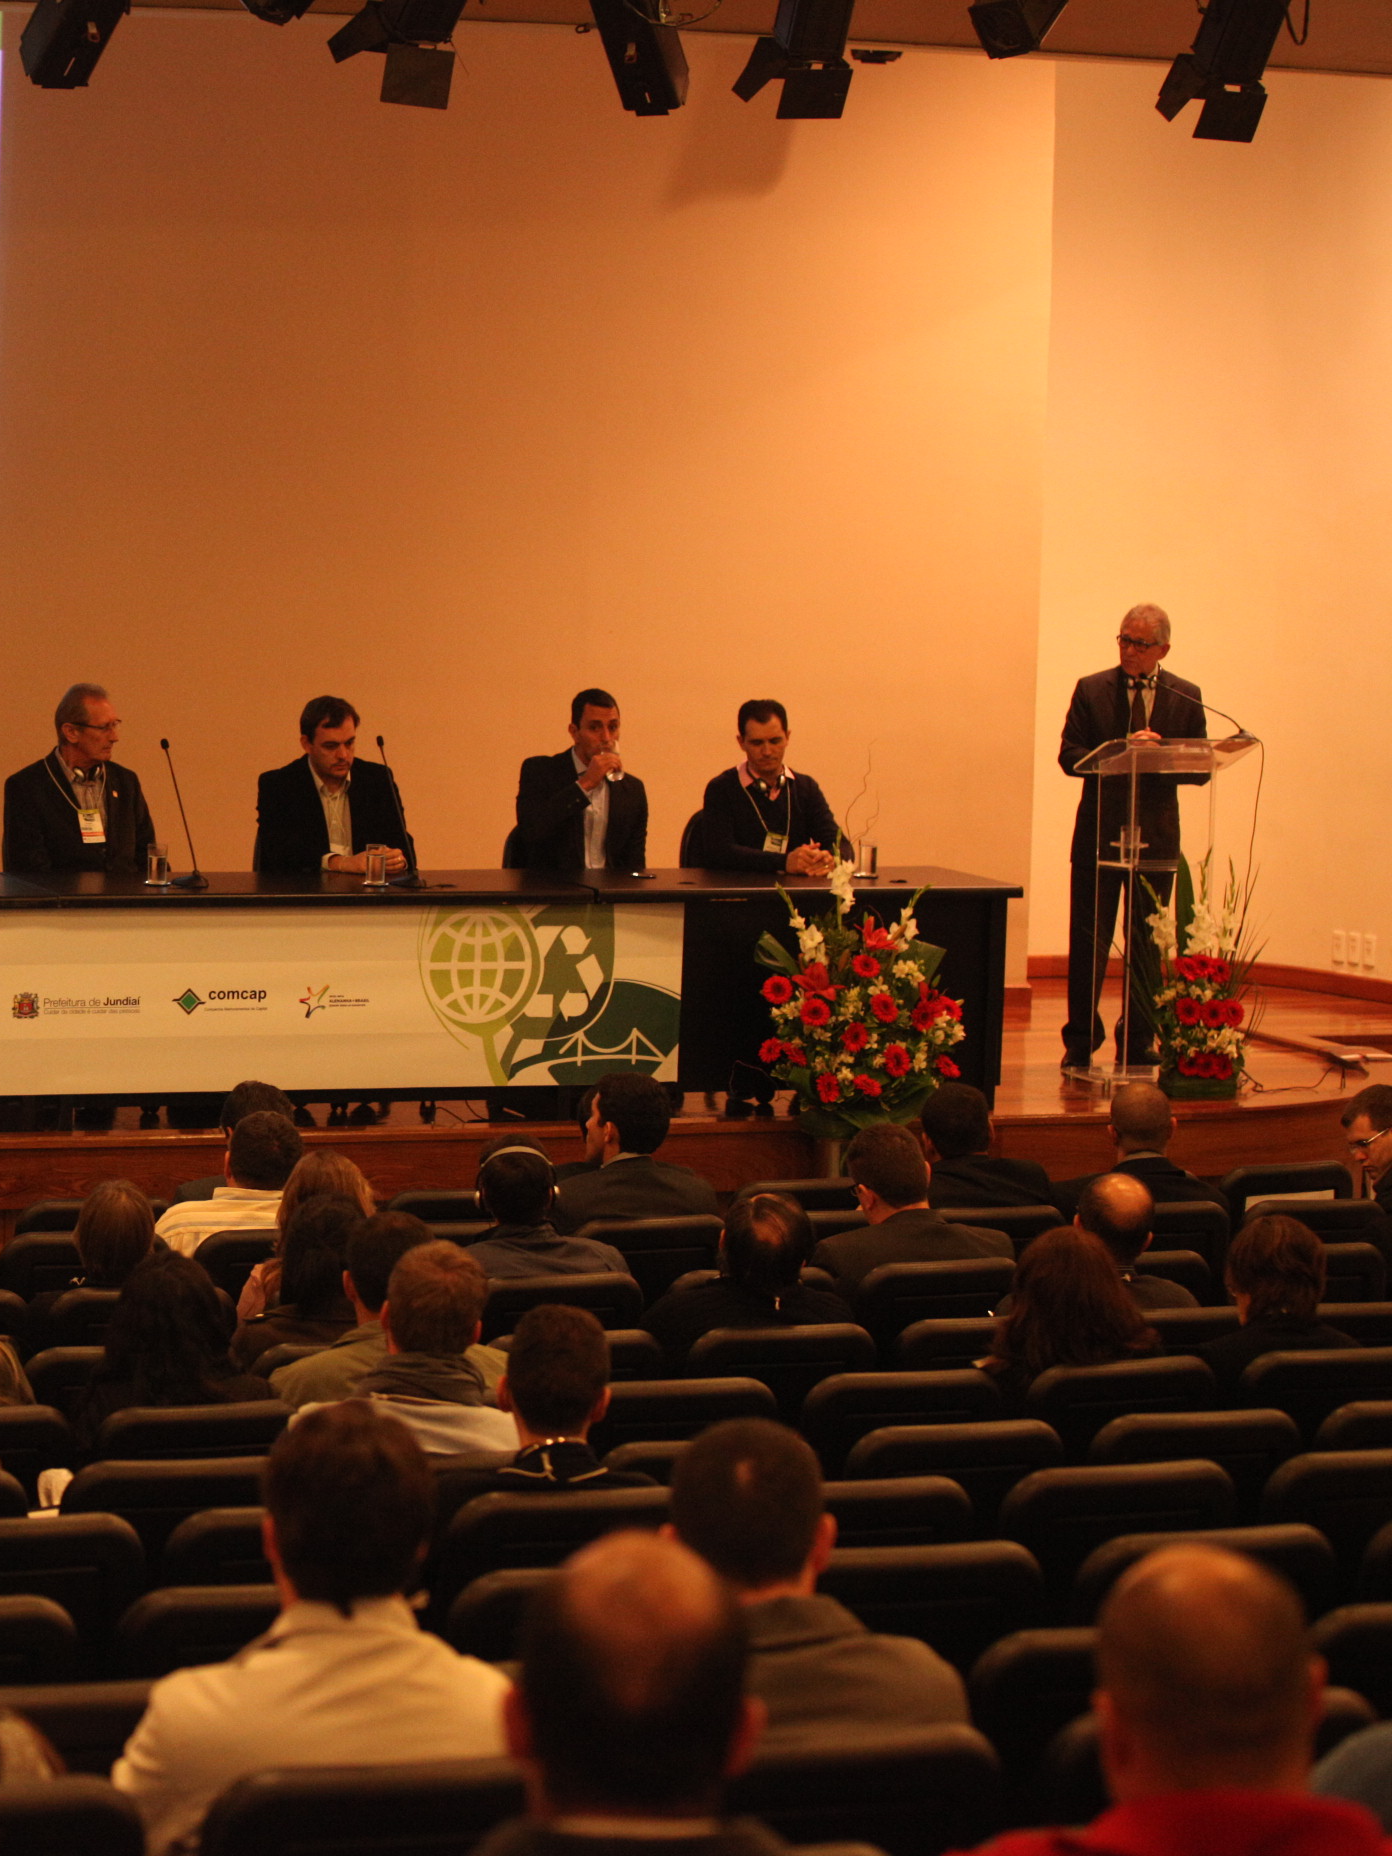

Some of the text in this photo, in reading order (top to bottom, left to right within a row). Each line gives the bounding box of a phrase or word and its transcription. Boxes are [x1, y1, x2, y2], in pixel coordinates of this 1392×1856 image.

[43, 995, 141, 1008] Prefeitura de Jundiaí
[208, 989, 267, 1002] comcap
